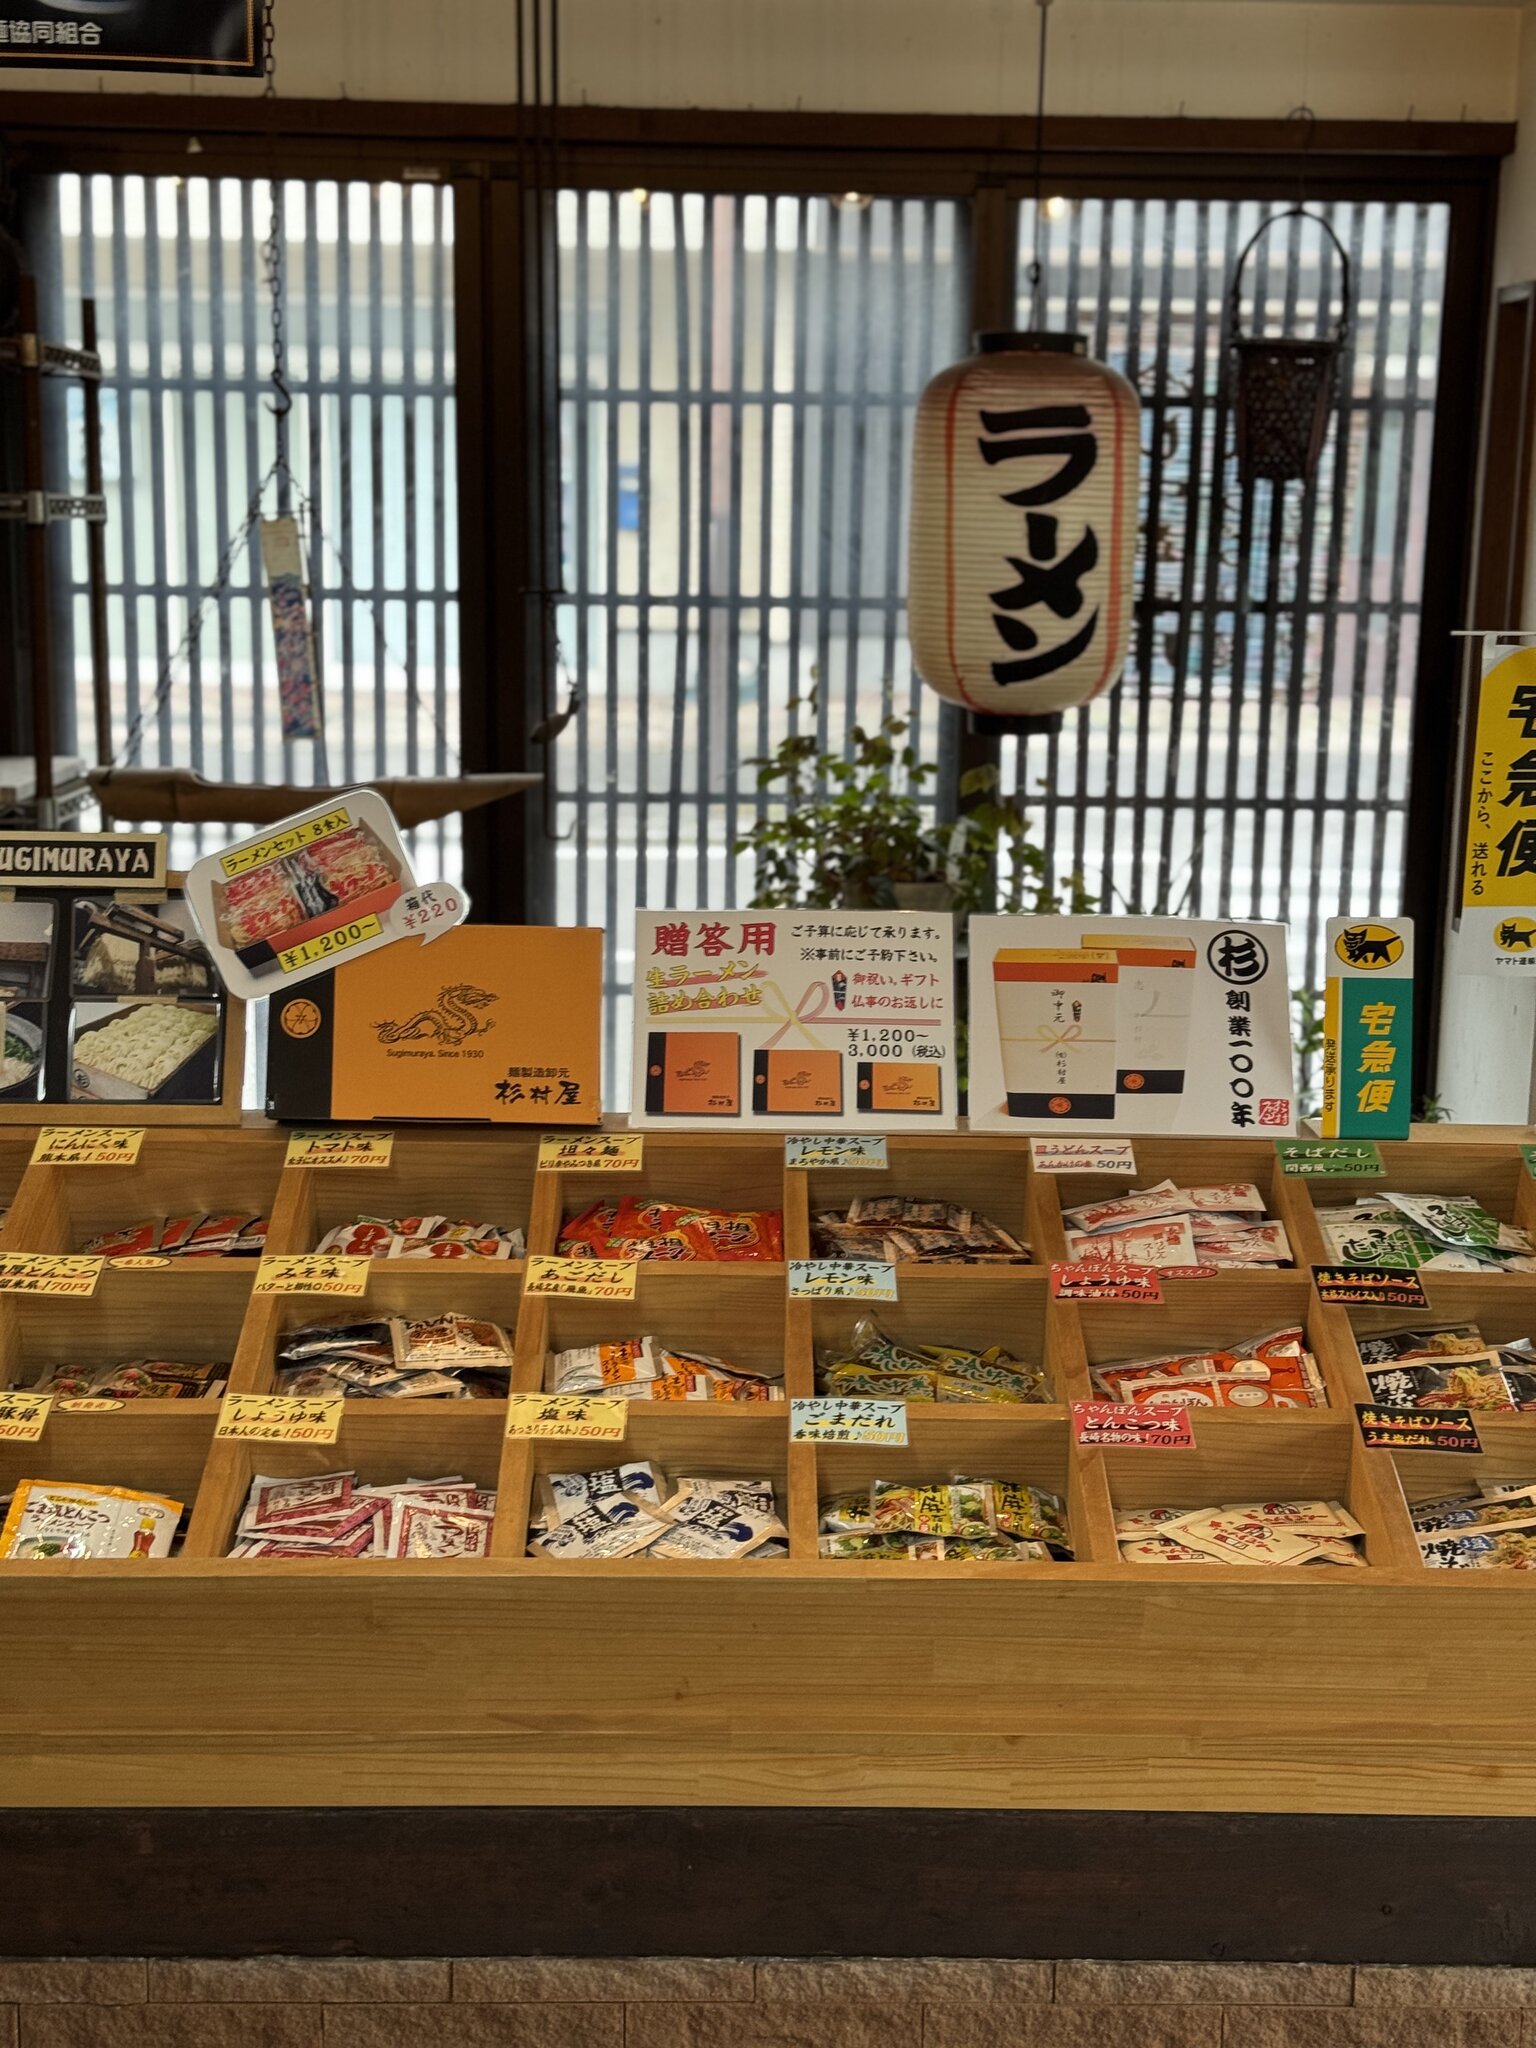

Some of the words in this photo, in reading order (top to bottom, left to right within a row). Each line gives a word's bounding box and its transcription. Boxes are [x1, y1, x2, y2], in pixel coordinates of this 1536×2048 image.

[978, 405, 1100, 686] ラーメン
[225, 831, 307, 872] ラーメンセット
[1470, 843, 1489, 896] 送れる
[405, 890, 437, 911] 箱代
[402, 897, 458, 930] ¥220
[791, 925, 940, 940] ご予算に応じて承ります。
[651, 922, 777, 957] 贈答用
[1218, 936, 1260, 979] 杉
[645, 960, 760, 989] 生ラーメン
[646, 983, 763, 1016] 詰め合わせ
[851, 995, 944, 1009] 仏事のお返しに
[462, 1050, 484, 1058] 1930
[848, 1044, 902, 1057] 3,000
[1357, 1002, 1396, 1113] 宅急便
[494, 1080, 582, 1105] 杉村屋
[42, 1129, 144, 1137] ラーメンスープ
[293, 1132, 393, 1140] ラーメンスープ
[49, 1139, 128, 1150] にんにく味
[308, 1141, 373, 1152] トマト味
[543, 1136, 640, 1144] ラーメンスープ
[786, 1137, 886, 1145] 冷やし中華スープ
[801, 1146, 866, 1156] レモン味
[1283, 1147, 1370, 1158] そばだし
[351, 1155, 388, 1164] 70円
[601, 1159, 639, 1168] 70円
[1096, 1160, 1132, 1169] 50円
[1344, 1164, 1379, 1172] 50円
[262, 1257, 369, 1267] ラーメンスープ
[531, 1257, 636, 1270] ラーメンスープ
[789, 1262, 895, 1273] 冷やし中華スープ
[275, 1267, 340, 1279] みそ味
[1050, 1263, 1154, 1275] ちゃんぽんスープ
[540, 1269, 623, 1283] あごだし
[805, 1272, 875, 1285] レモン味
[1060, 1274, 1152, 1288] しょうゆ味
[1318, 1271, 1420, 1289] 焼きそばソース
[51, 1282, 90, 1292] 70円
[321, 1282, 362, 1293] 50円
[594, 1286, 633, 1296] 70円
[1121, 1289, 1159, 1300] 50円
[1387, 1292, 1424, 1304] 50円
[228, 1395, 343, 1409] ラーメンスープ
[513, 1395, 624, 1409] ラーメンスープ
[792, 1400, 905, 1413] 冷やし中華スープ
[233, 1408, 326, 1423] しょうゆ味
[537, 1407, 587, 1421] 塩味
[1073, 1404, 1185, 1416] ちゃんぽんスープ
[805, 1412, 896, 1428] ごまだれ
[1084, 1416, 1180, 1432] とんこつ味
[1362, 1411, 1472, 1431] 焼きそばソース
[291, 1427, 334, 1439] 50円
[580, 1426, 622, 1437] 50円
[1151, 1434, 1191, 1445] 70円
[1437, 1436, 1479, 1448] 50円
[31, 1514, 95, 1530] ラメンスープ
